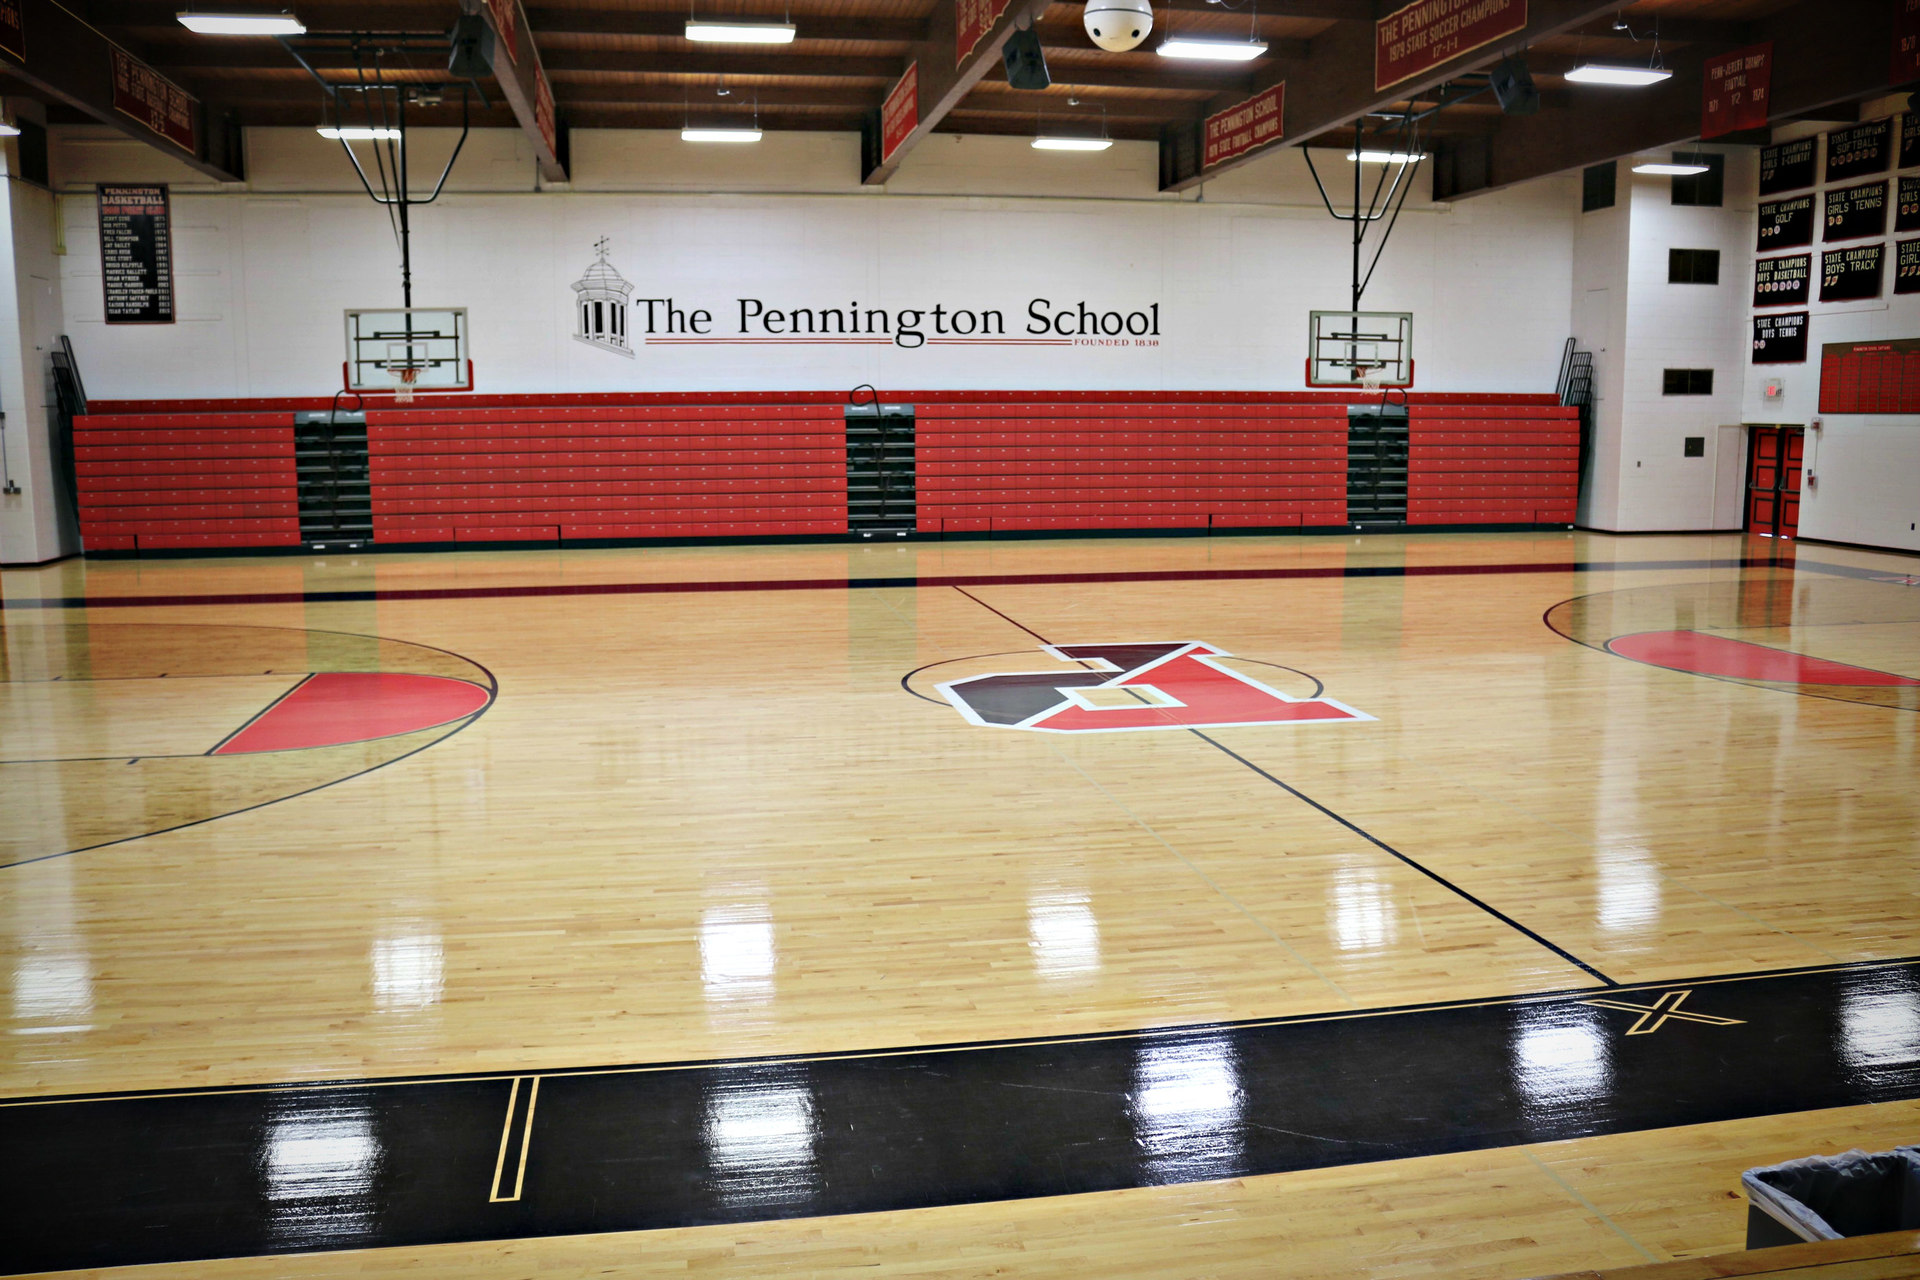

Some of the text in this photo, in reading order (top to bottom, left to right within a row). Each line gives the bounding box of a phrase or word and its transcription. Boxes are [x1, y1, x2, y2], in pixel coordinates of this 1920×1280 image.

[1380, 20, 1398, 46] THE
[1389, 0, 1510, 63] 1979 STATE SOCCER CHAMPIONS
[1837, 136, 1879, 154] SOFTBALL
[102, 196, 164, 204] BASKETBALL
[1828, 185, 1883, 204] STATE CHAMPIONS
[1761, 198, 1810, 216] STATE CHAMPIONS
[1827, 197, 1882, 215] GIRLS TENNIS
[1775, 212, 1794, 224] GOLF
[1825, 248, 1879, 264] STATE CHAMPIONS
[1901, 242, 1920, 254] STATE
[1759, 257, 1807, 271] STATE CHAMPIONS
[1825, 259, 1876, 275] BOYS TRACK
[1757, 268, 1807, 282] BOYS BASKETBALL
[636, 298, 1161, 349] The Pennington School
[1757, 315, 1803, 328] STATE CHAMPIONS
[1762, 327, 1797, 339] BOYS TENNIS
[1074, 338, 1159, 347] FOUNDED 1838
